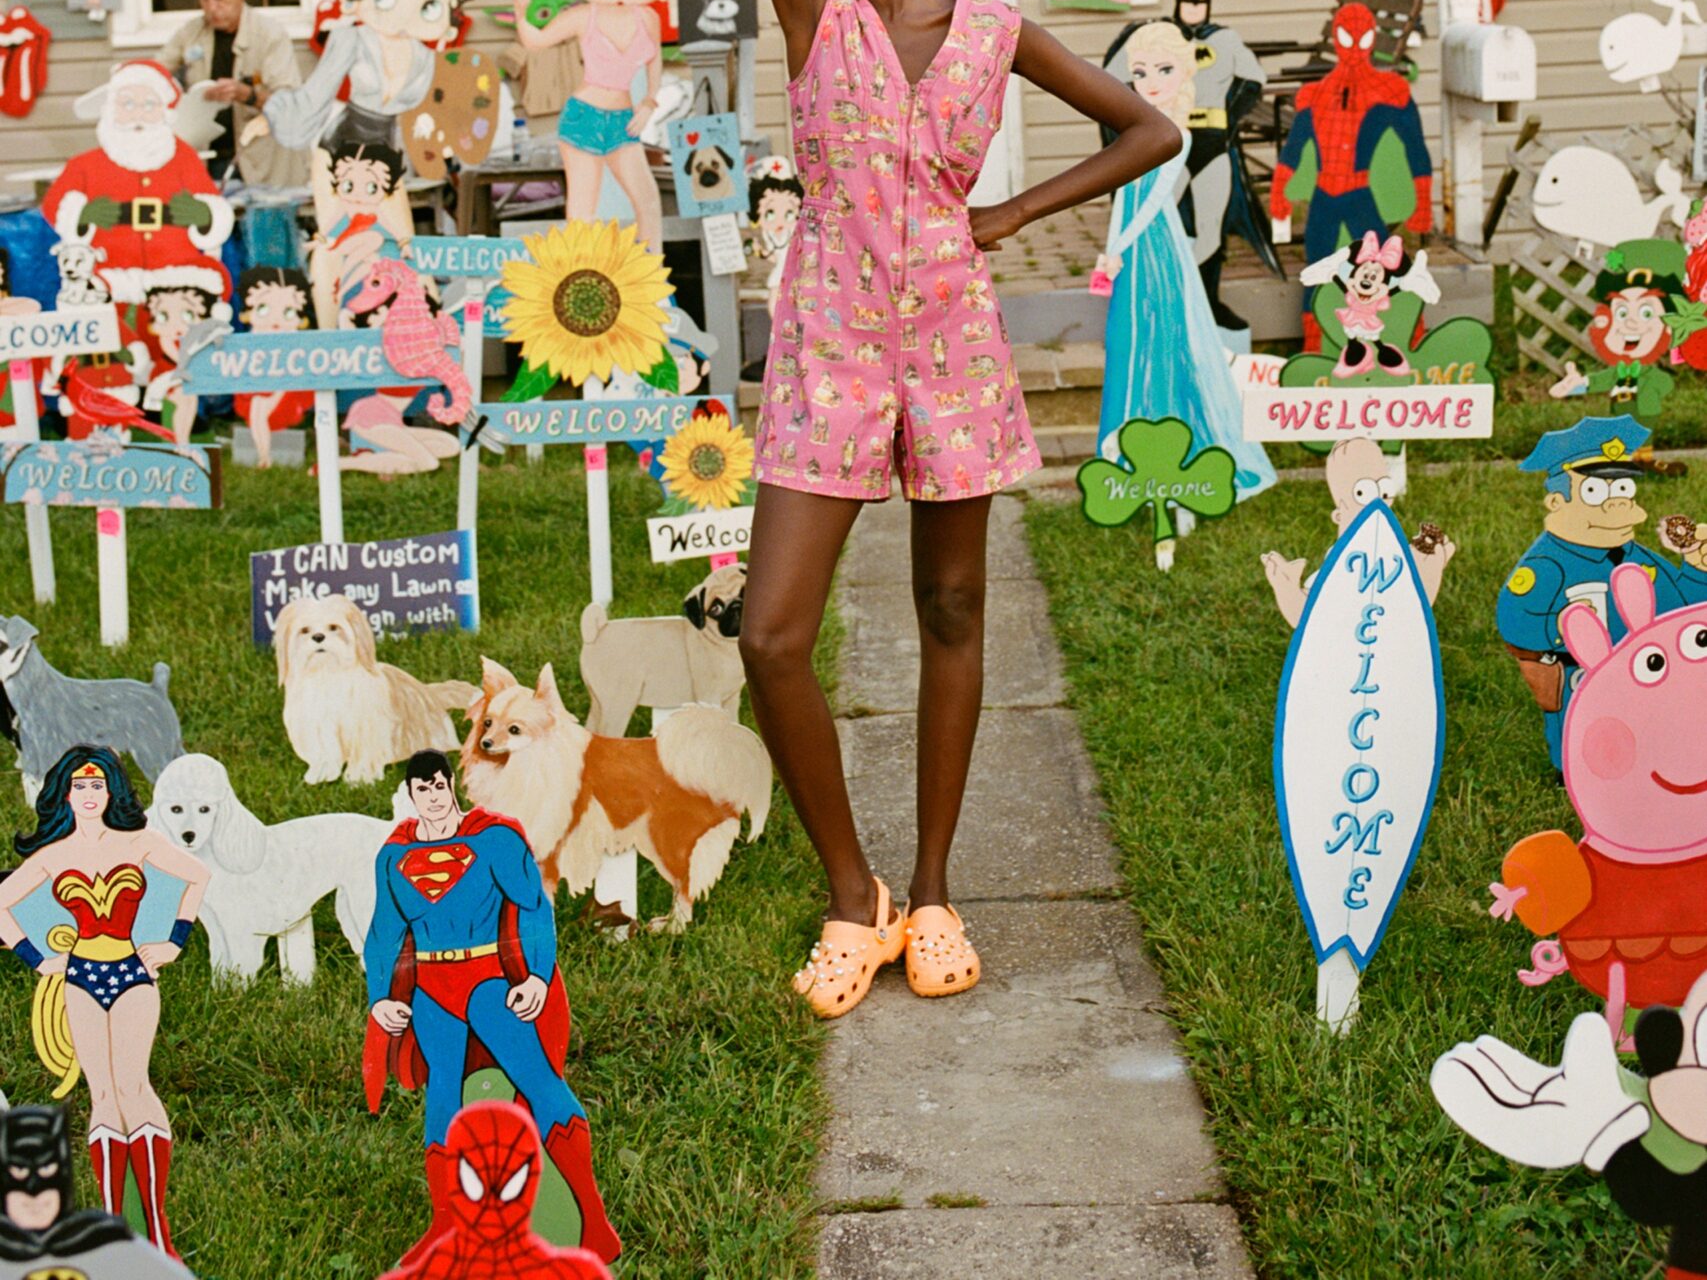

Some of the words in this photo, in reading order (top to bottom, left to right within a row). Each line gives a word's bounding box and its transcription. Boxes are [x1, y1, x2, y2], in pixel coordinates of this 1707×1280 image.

[416, 247, 532, 271] WELCOM
[0, 320, 99, 350] COME
[211, 344, 383, 377] WELCOME
[504, 404, 689, 436] WELCOME
[1268, 397, 1474, 431] WELCOME
[19, 463, 198, 494] WELCOME
[1104, 477, 1216, 501] Welcome
[658, 522, 750, 552] Welco
[270, 550, 286, 576] I
[293, 543, 349, 575] CAN
[264, 577, 331, 607] Make
[343, 582, 380, 607] any
[391, 571, 451, 598] Lawn
[406, 602, 456, 624] with
[1325, 551, 1403, 909] WELCOME
